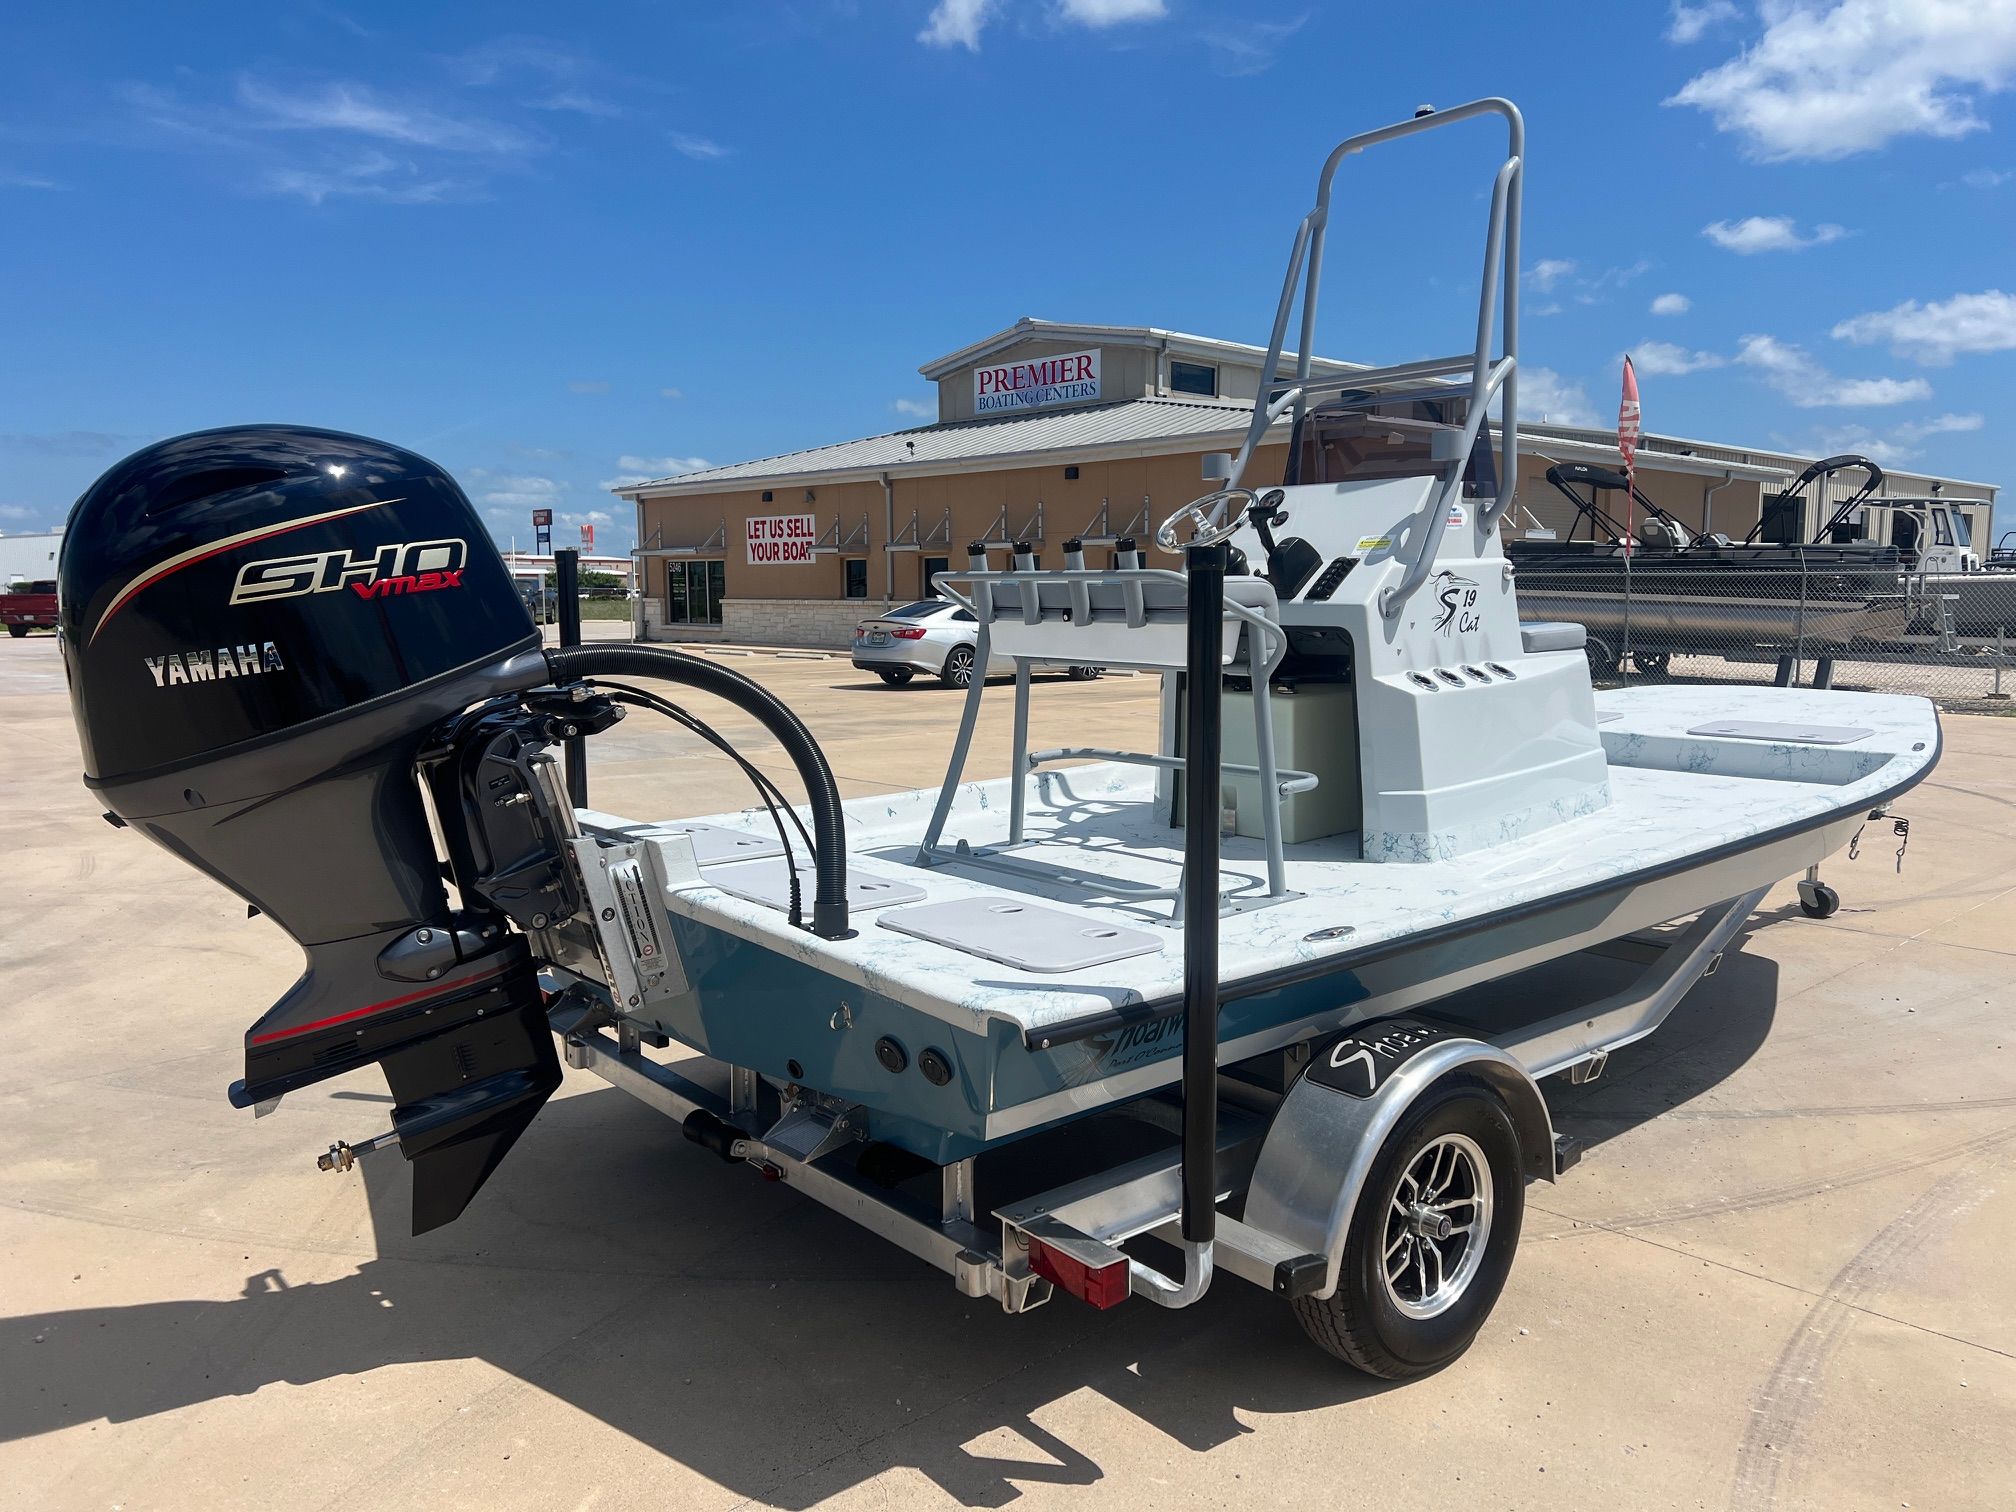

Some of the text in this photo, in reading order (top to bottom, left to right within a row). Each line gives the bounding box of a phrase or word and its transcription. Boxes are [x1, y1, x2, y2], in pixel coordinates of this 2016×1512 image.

[978, 354, 1096, 395] PREMIER
[978, 381, 1096, 411] BOATING CENTERS
[748, 517, 814, 539] LET US SELL
[750, 542, 780, 561] YOUR
[229, 537, 468, 606] SHO
[1463, 589, 1477, 607] 19
[1459, 611, 1481, 633] Cat
[144, 641, 285, 687] YAMAHA
